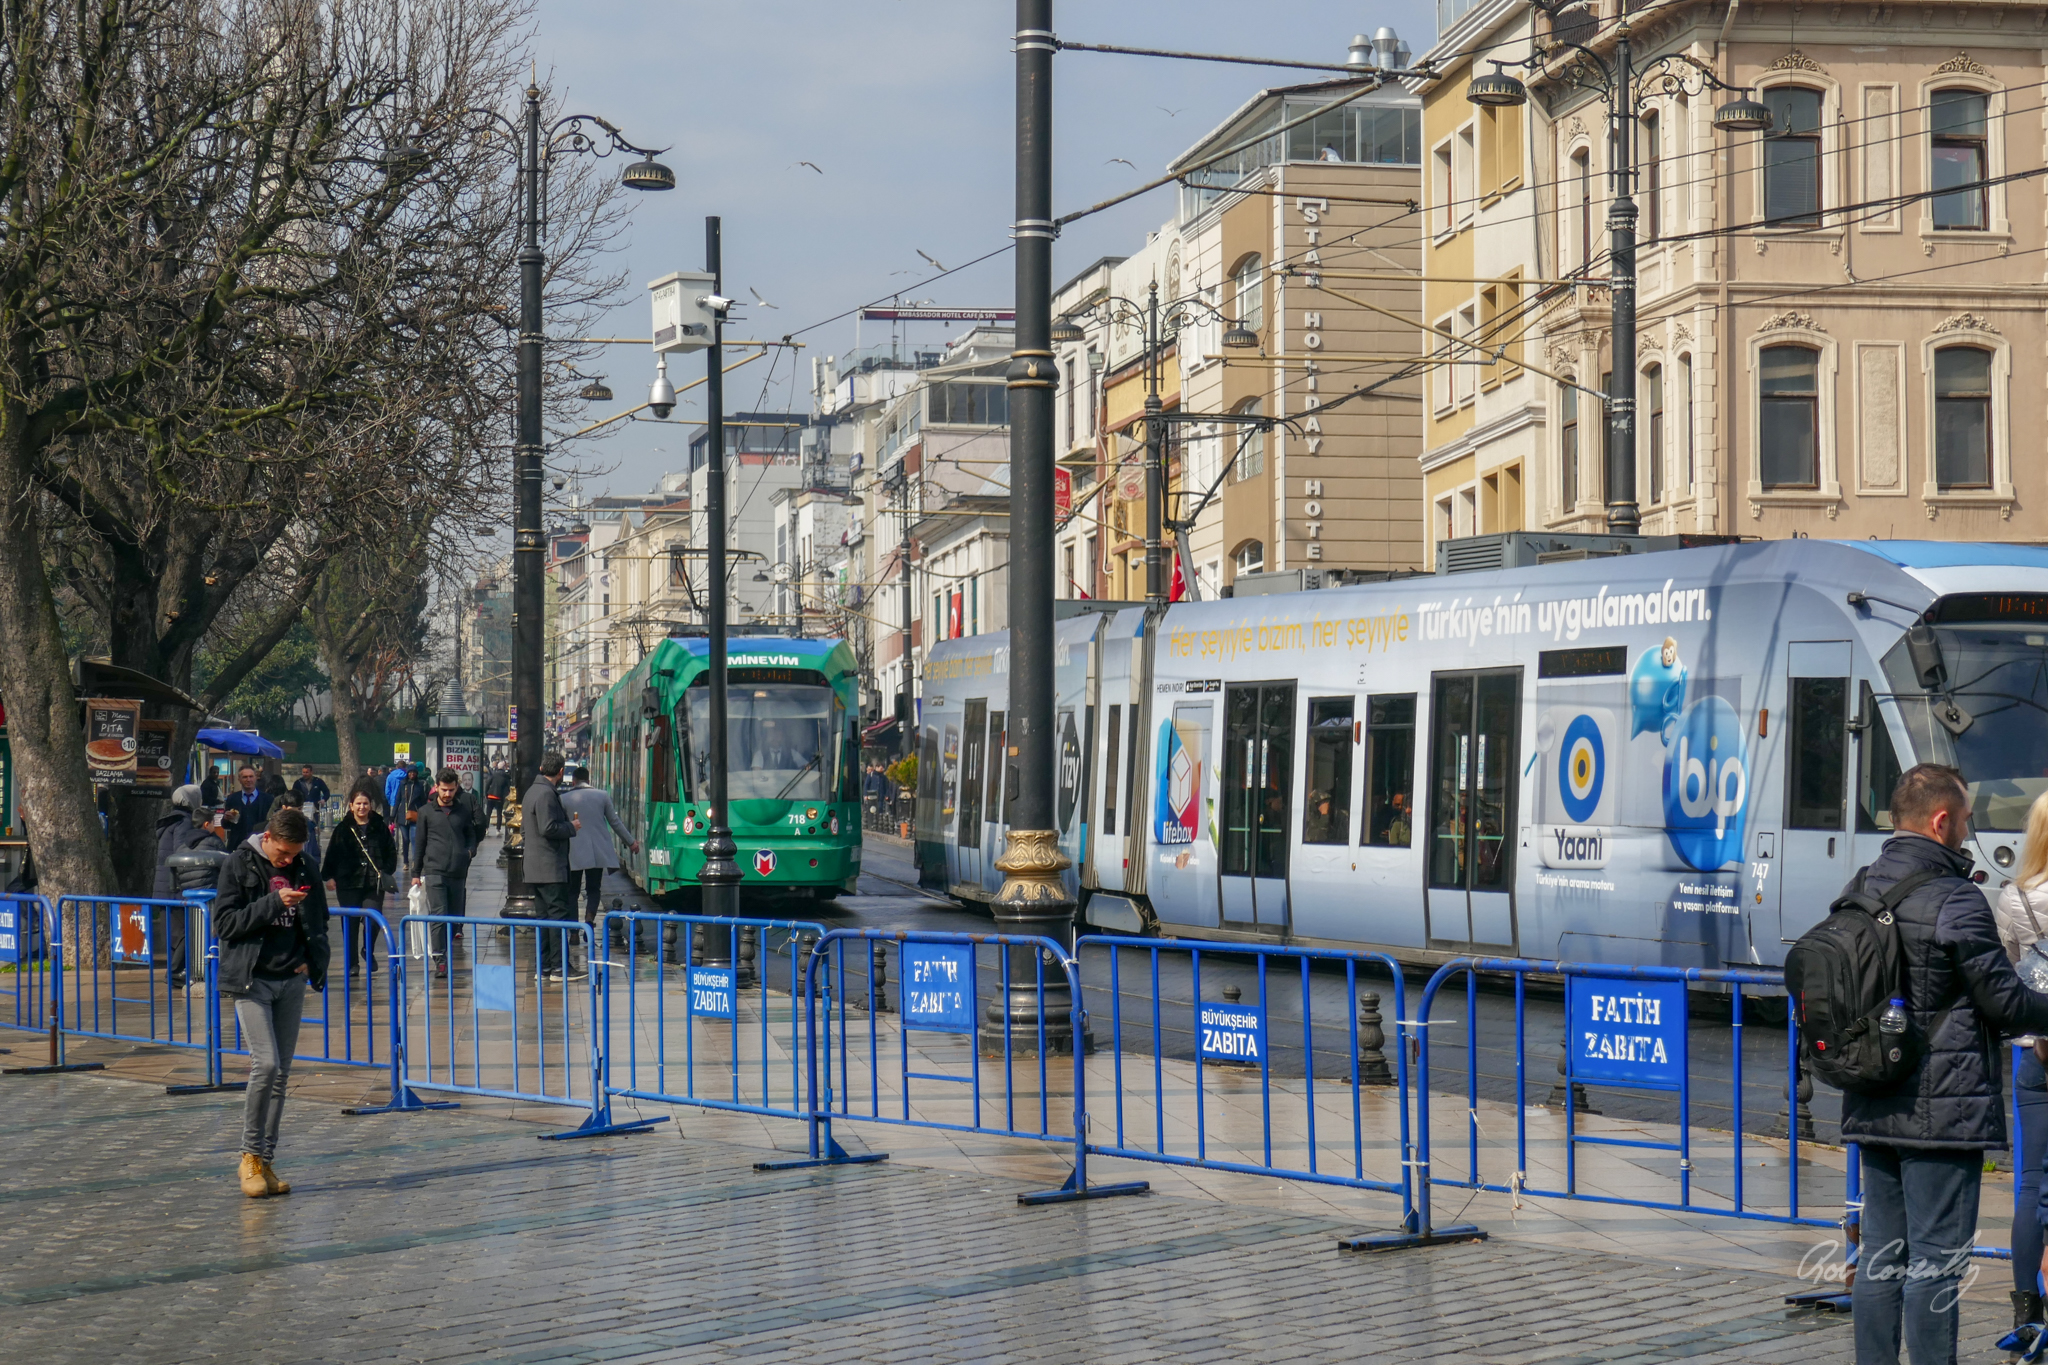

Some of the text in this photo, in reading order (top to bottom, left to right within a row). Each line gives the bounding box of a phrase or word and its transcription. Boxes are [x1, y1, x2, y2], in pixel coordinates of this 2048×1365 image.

[1304, 480, 1321, 569] HOTE
[1170, 578, 1712, 663] Her şeyiyle bizim, her şeyiyle Türkiye'nin uygulamaları.
[111, 711, 130, 719] Menu
[101, 724, 123, 733] PITA
[446, 746, 469, 754] BİZİM
[446, 755, 464, 763] BİR
[788, 814, 806, 824] 718
[794, 828, 801, 836] A
[1163, 821, 1193, 844] lifebox
[1554, 828, 1603, 861] Yaani
[1751, 862, 1769, 880] 747
[1536, 873, 1615, 891] Türkiye'nin arama motoru
[1679, 882, 1734, 898] Yeni nesil iletişim
[1757, 879, 1764, 891] A
[1673, 901, 1739, 914] ve yaşam platformu
[693, 971, 729, 989] BÜYÜKŞEHİR
[693, 989, 730, 1013] ZABITA
[1591, 992, 1660, 1025] FATİH
[1201, 1008, 1258, 1031] BÜYÜKŞEHİR
[1203, 1029, 1258, 1057] ZABITA
[1585, 1031, 1668, 1064] ZABITA
